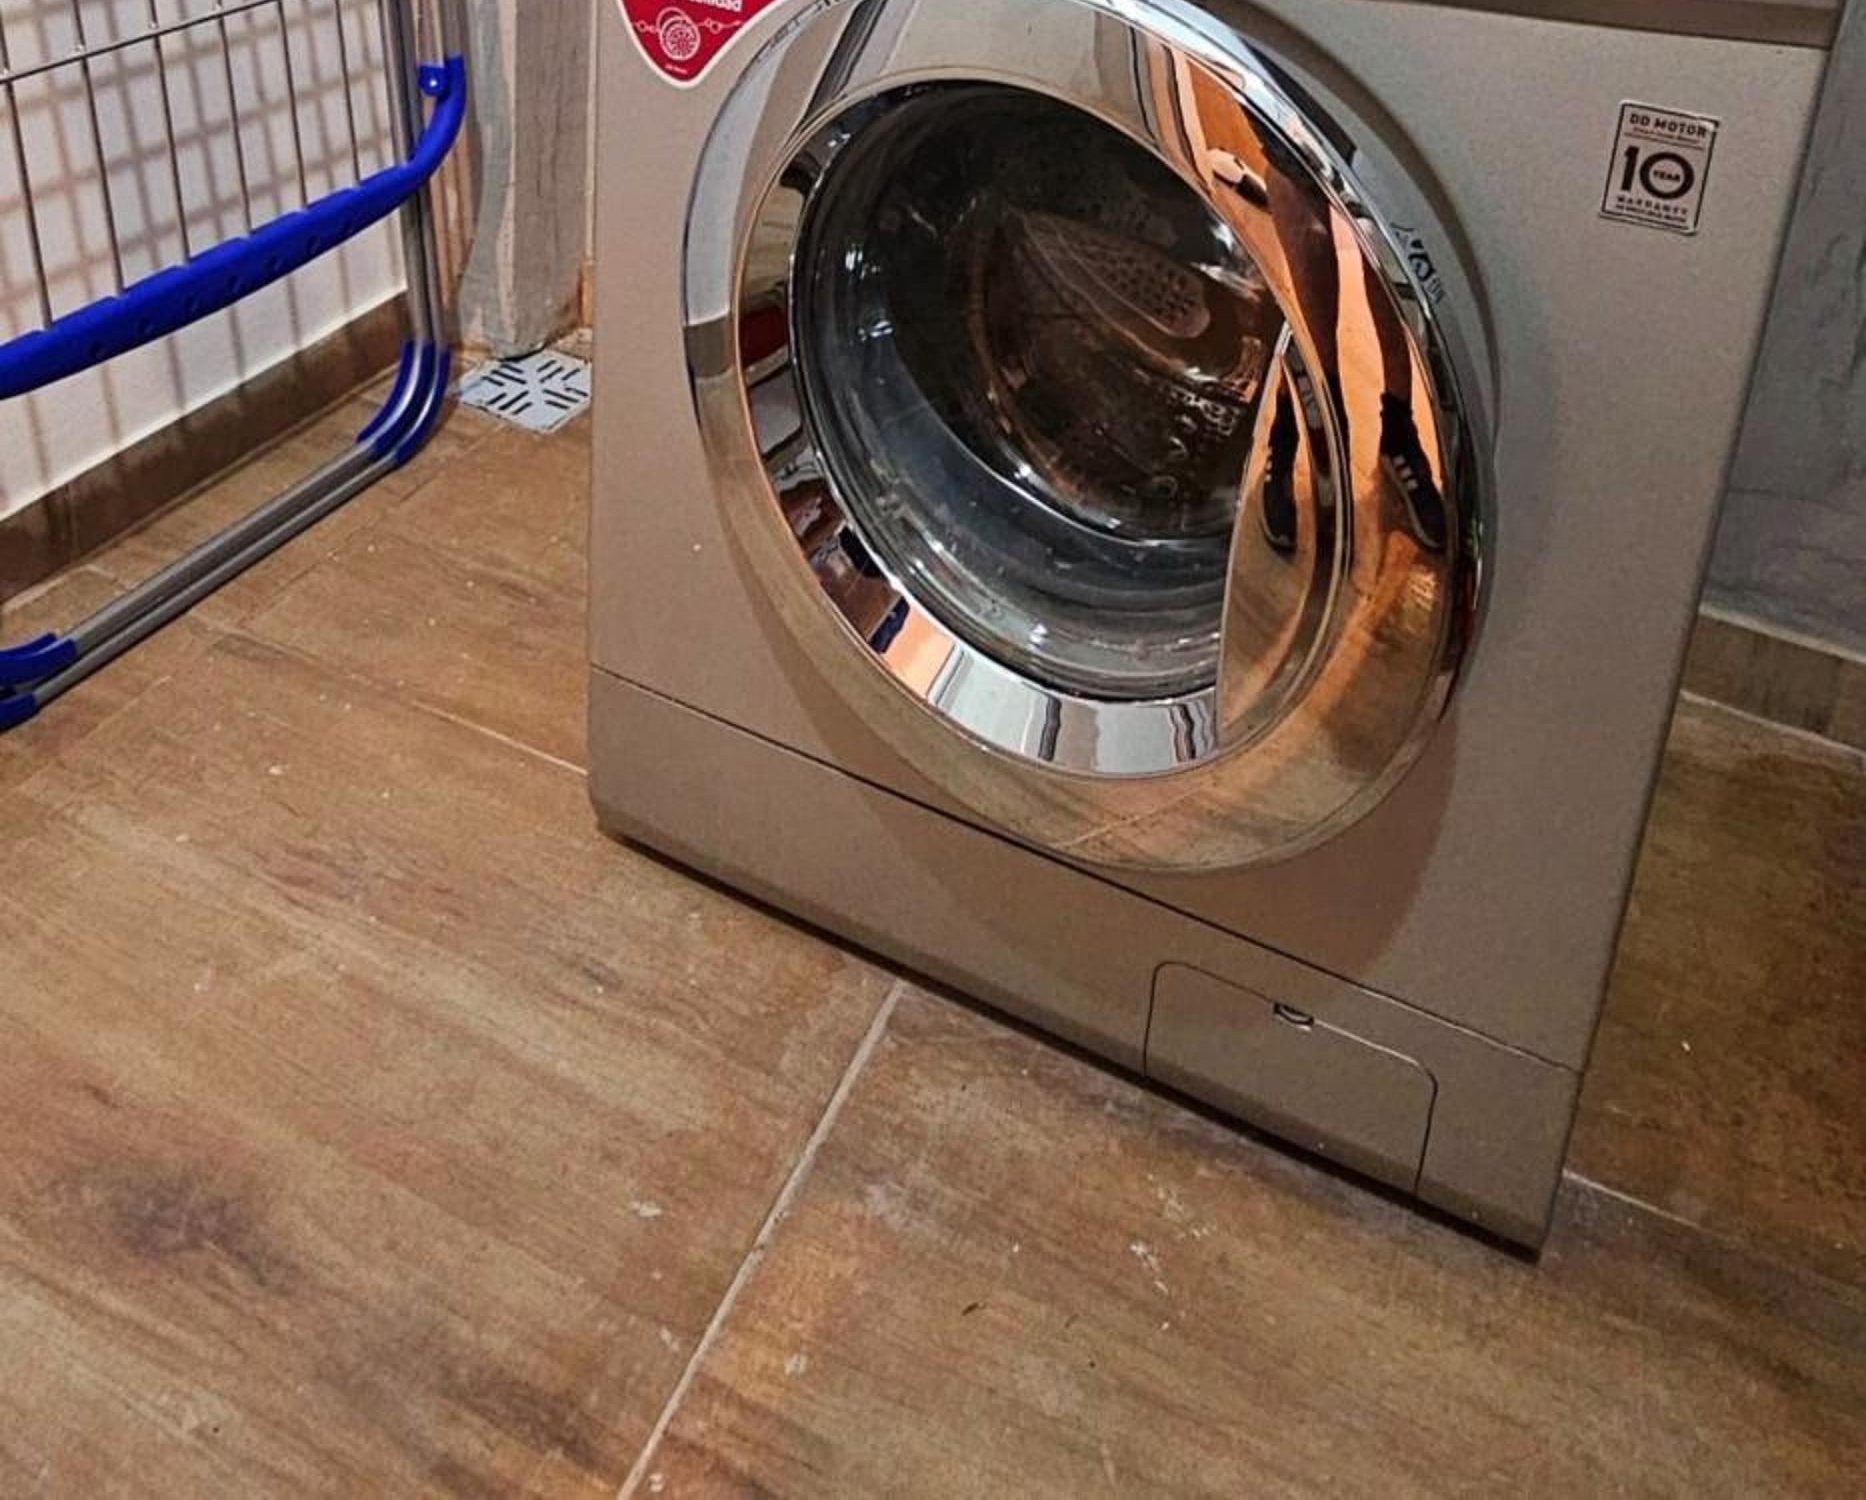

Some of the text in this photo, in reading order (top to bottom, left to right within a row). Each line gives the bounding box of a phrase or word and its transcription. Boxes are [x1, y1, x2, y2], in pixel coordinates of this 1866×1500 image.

[1629, 113, 1651, 127] DD
[1654, 117, 1707, 138] MOTOR
[1620, 145, 1695, 200] 10
